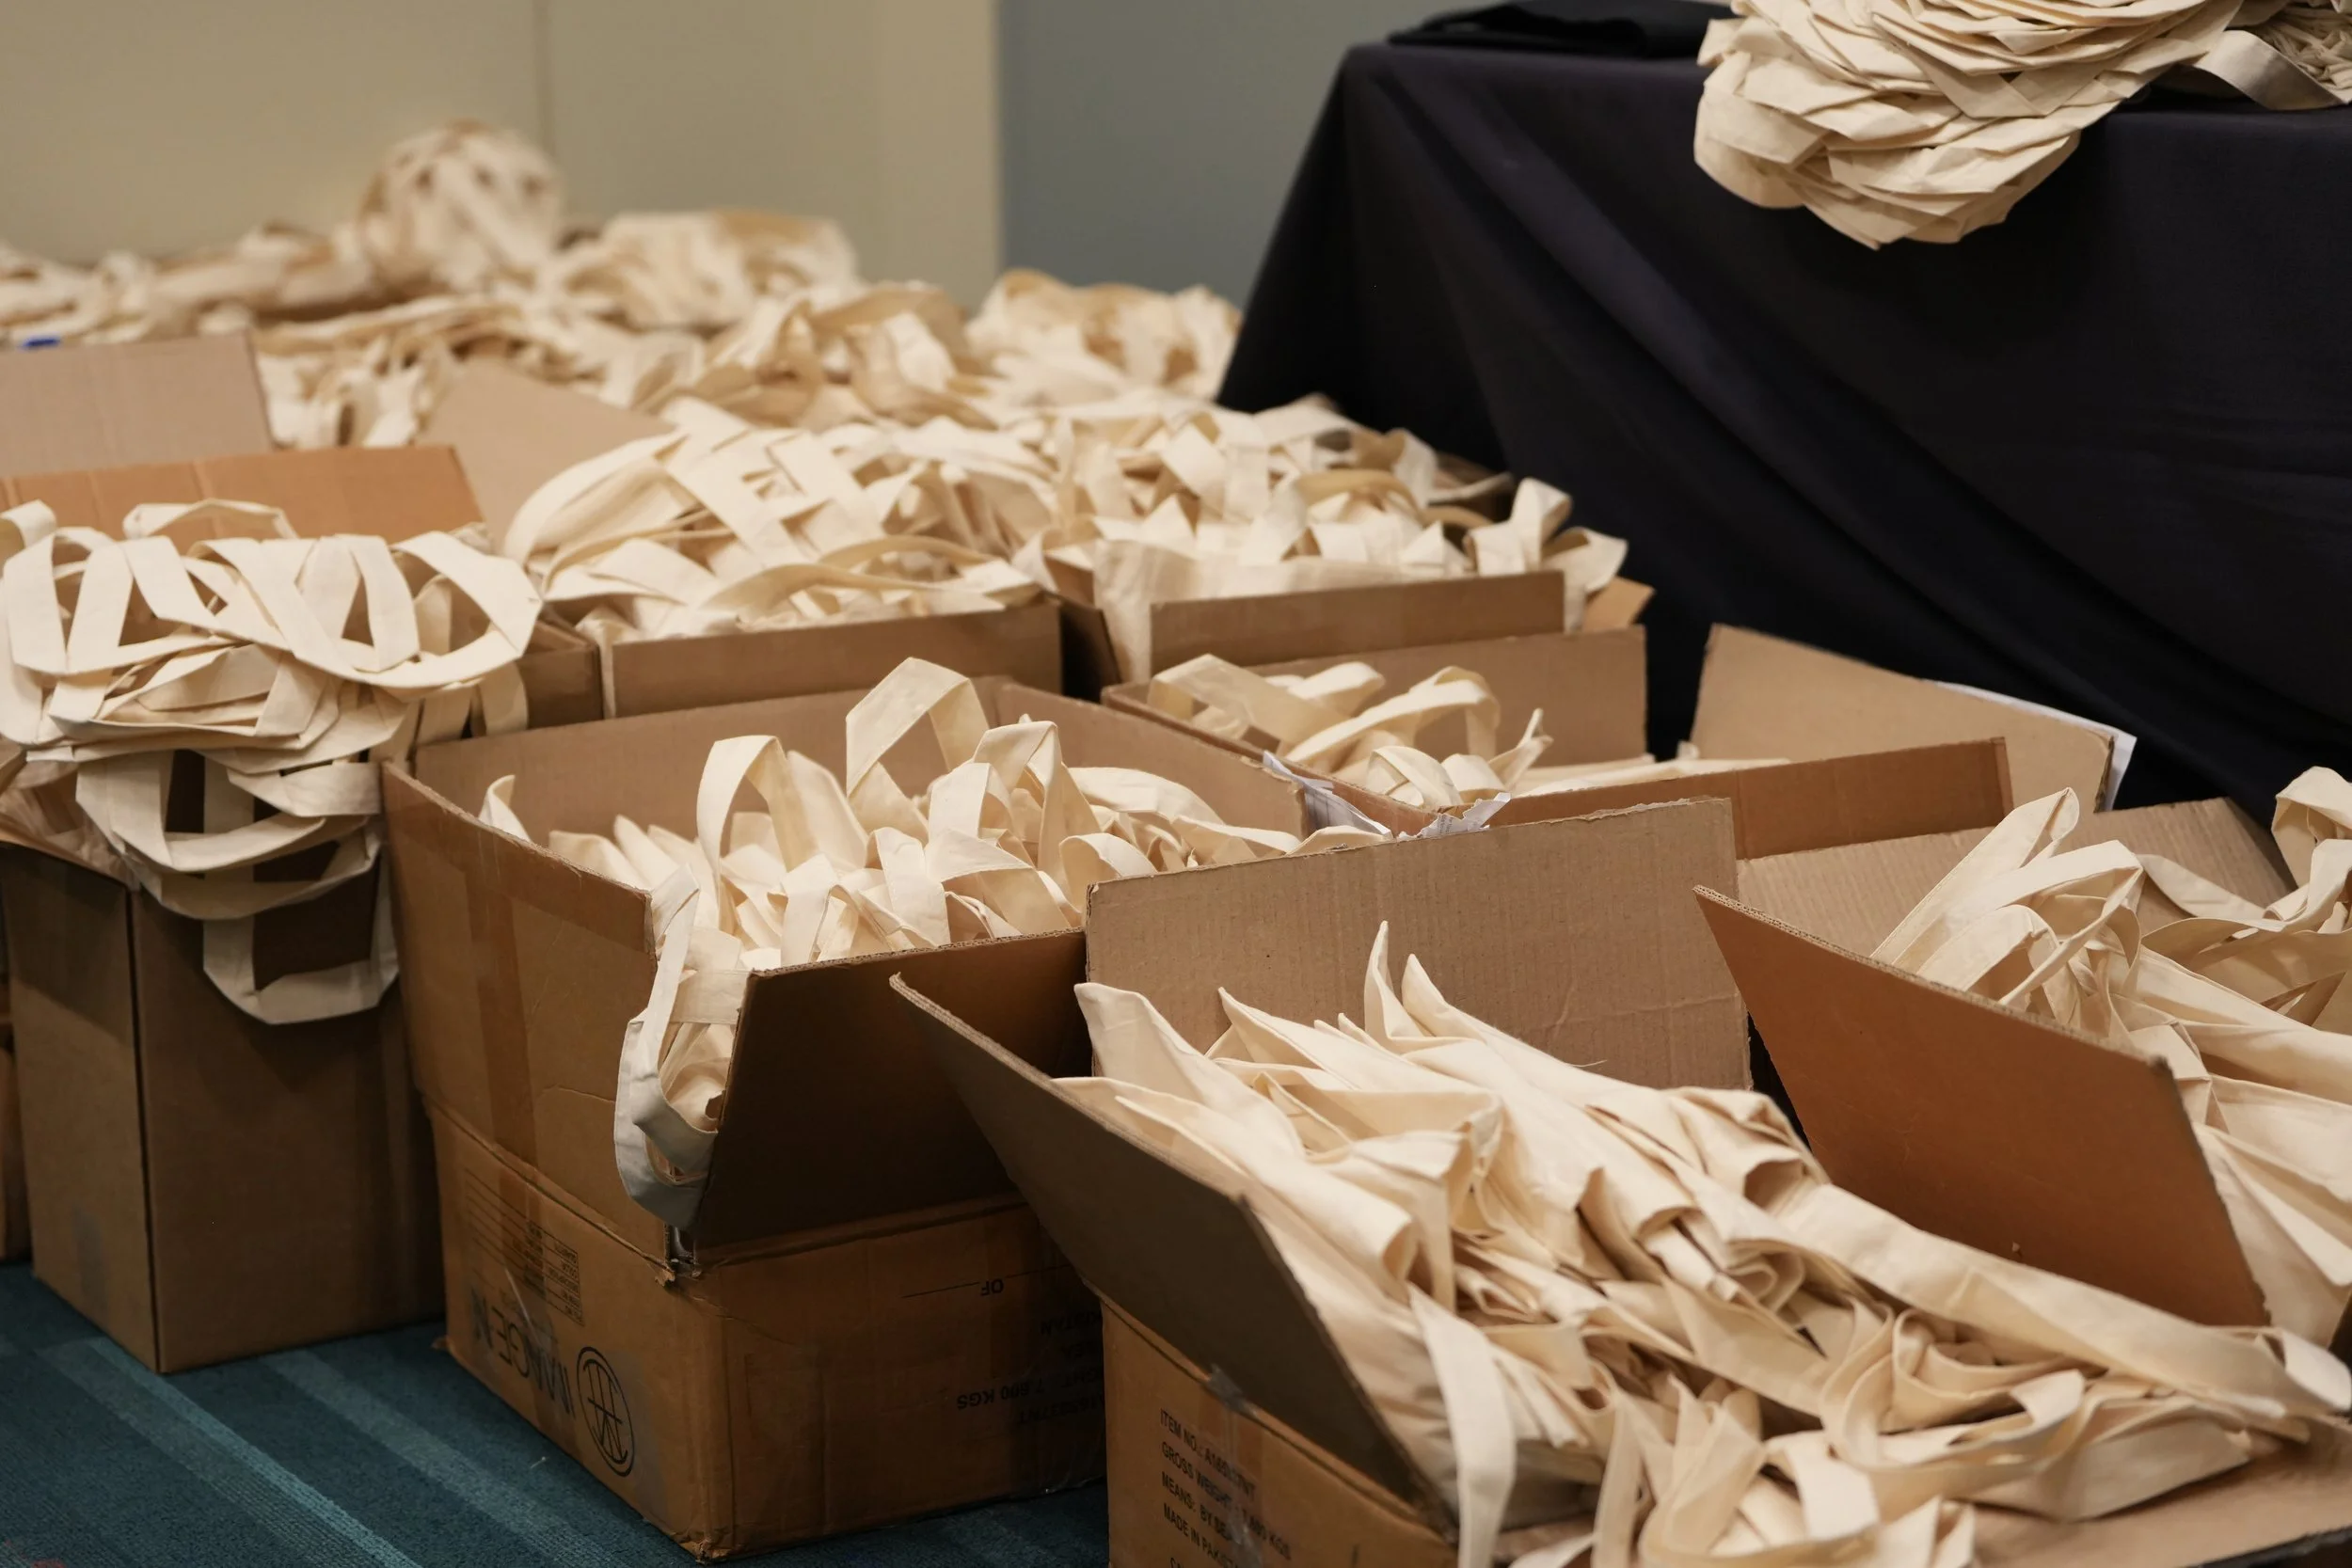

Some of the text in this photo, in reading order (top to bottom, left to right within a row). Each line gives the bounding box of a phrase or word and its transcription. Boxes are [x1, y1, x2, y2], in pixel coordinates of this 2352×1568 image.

[980, 1278, 1005, 1297] OF
[957, 1388, 995, 1410] KGS
[1160, 1408, 1182, 1439] ITEM
[1161, 1441, 1194, 1480] GROSS
[1163, 1502, 1188, 1538] MADE
[1190, 1527, 1200, 1547] IN
